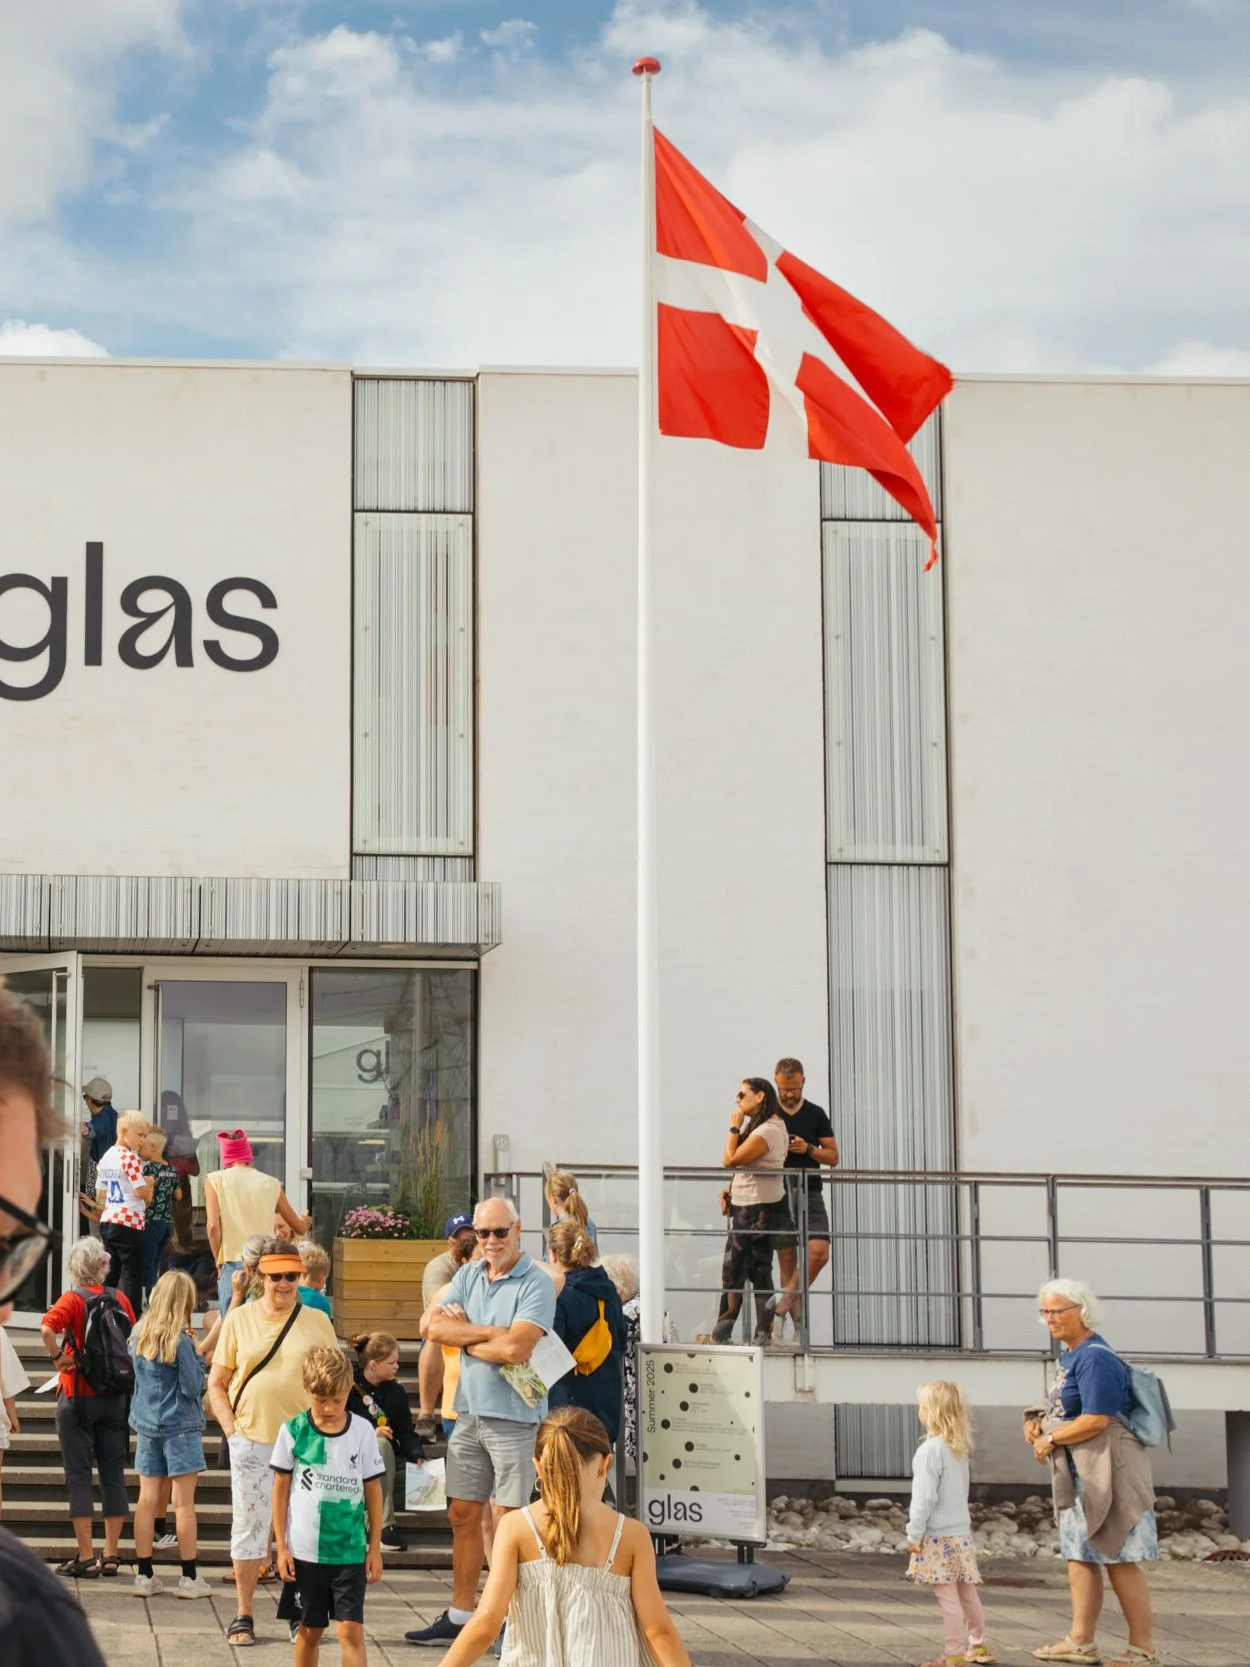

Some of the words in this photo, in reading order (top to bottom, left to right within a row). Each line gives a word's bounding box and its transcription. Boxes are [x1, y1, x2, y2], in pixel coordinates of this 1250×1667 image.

[646, 1359, 655, 1386] 2025
[647, 1388, 656, 1434] Summer
[315, 1481, 360, 1494] chartered
[648, 1493, 703, 1526] glas
